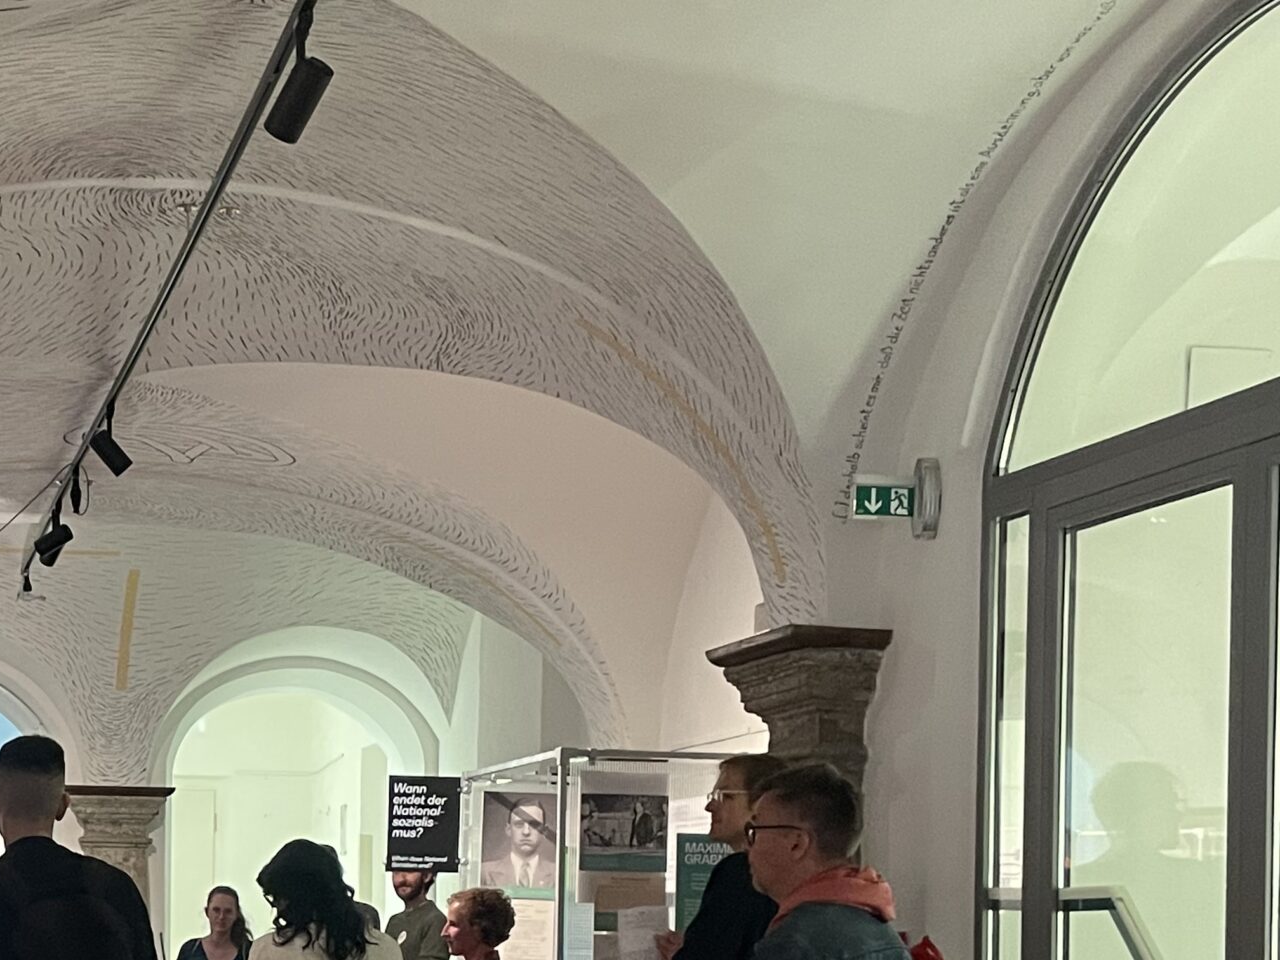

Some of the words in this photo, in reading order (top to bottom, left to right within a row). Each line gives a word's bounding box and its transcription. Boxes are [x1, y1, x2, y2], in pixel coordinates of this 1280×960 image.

[886, 325, 904, 345] die
[393, 782, 428, 794] Wann
[392, 794, 426, 806] endet
[426, 794, 449, 806] der
[392, 804, 446, 816] National-
[391, 816, 439, 828] sozialis-
[391, 827, 424, 839] mus?
[685, 842, 727, 854] MAXIM
[684, 853, 723, 866] GRAB
